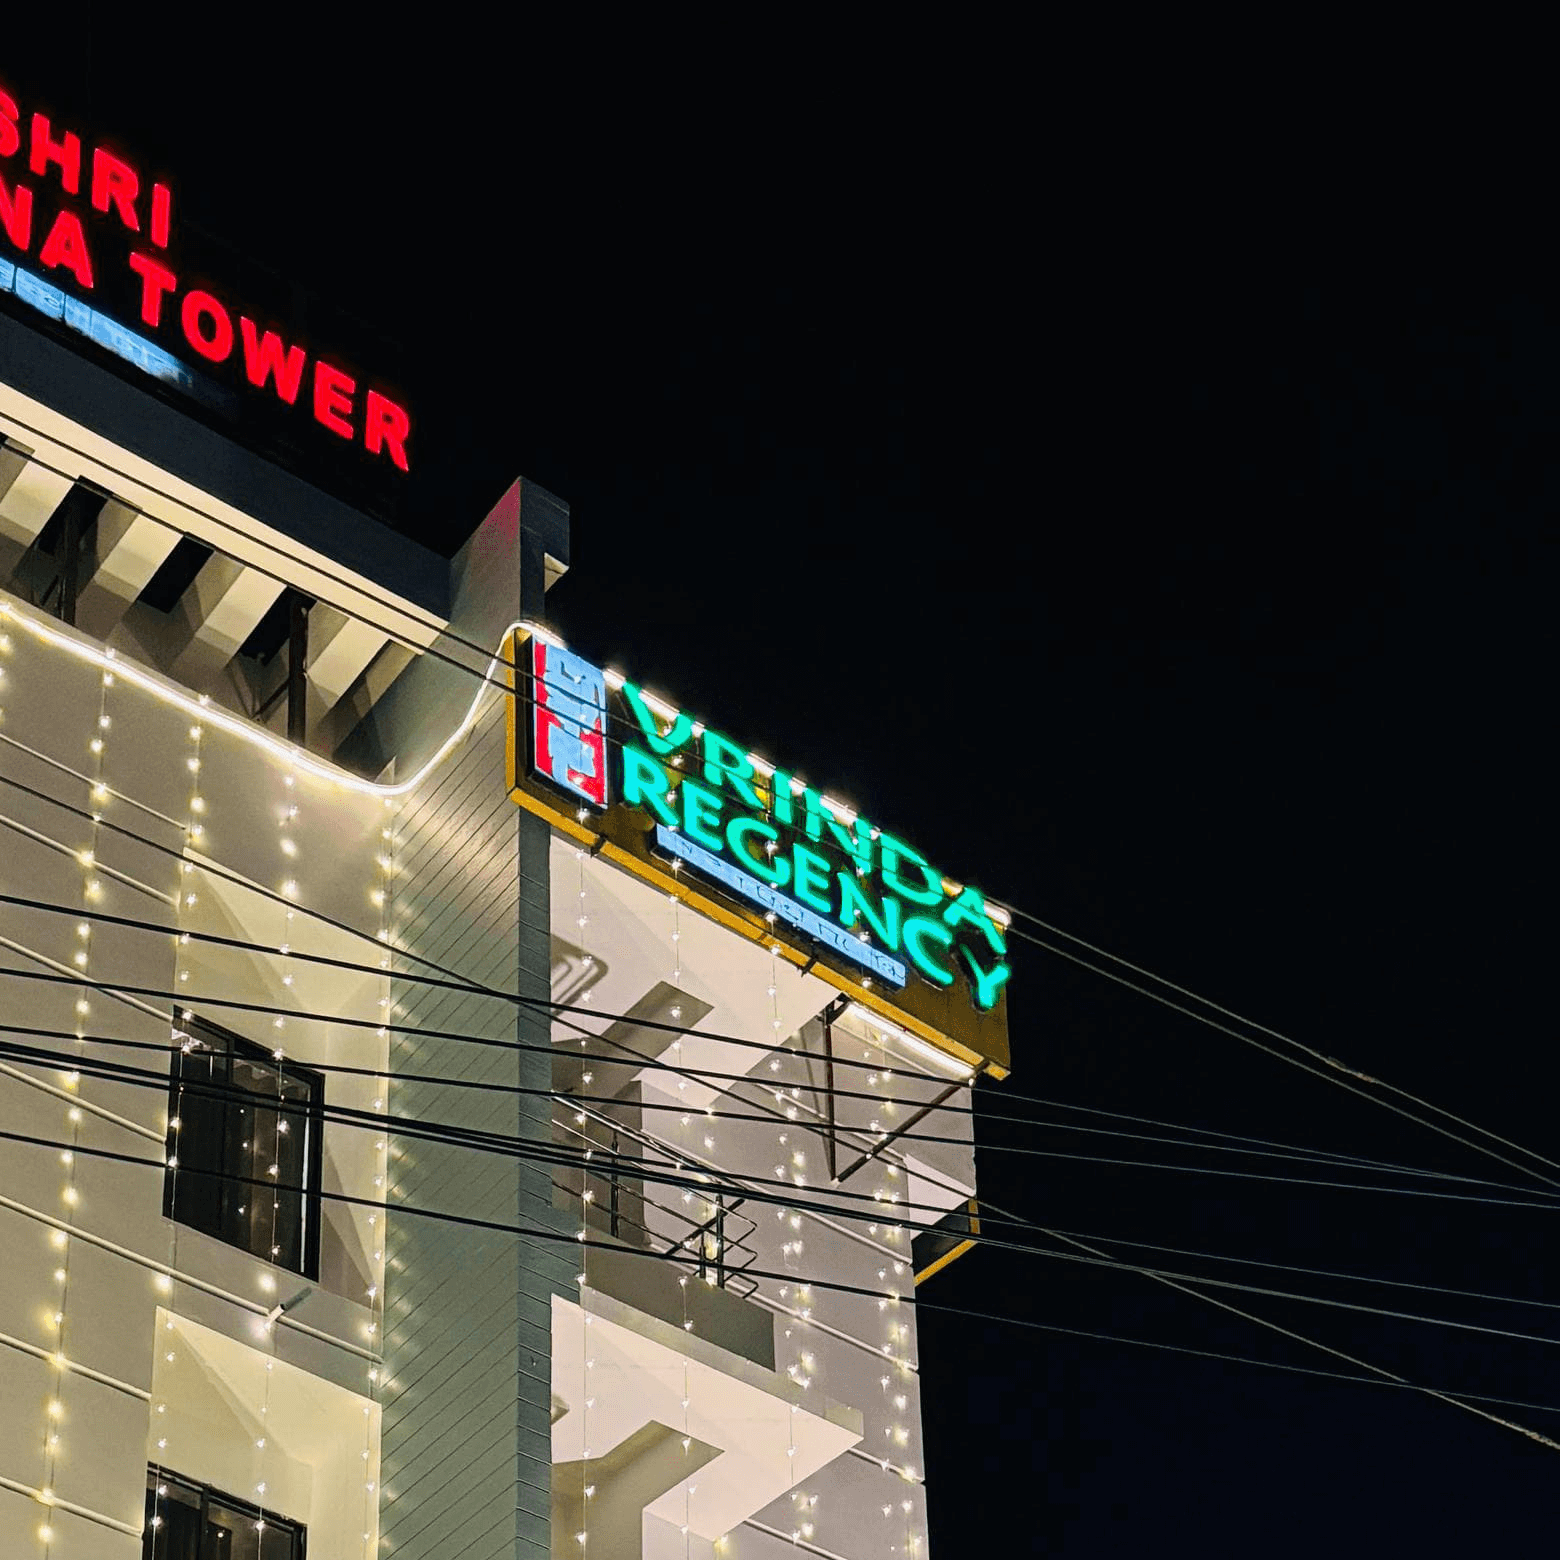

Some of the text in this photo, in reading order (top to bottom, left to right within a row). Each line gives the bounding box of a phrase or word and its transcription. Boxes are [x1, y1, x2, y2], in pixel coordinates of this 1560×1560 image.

[129, 251, 410, 472] TOWER
[621, 744, 1011, 1010] REGENCY
[622, 679, 1007, 955] VRINDA
